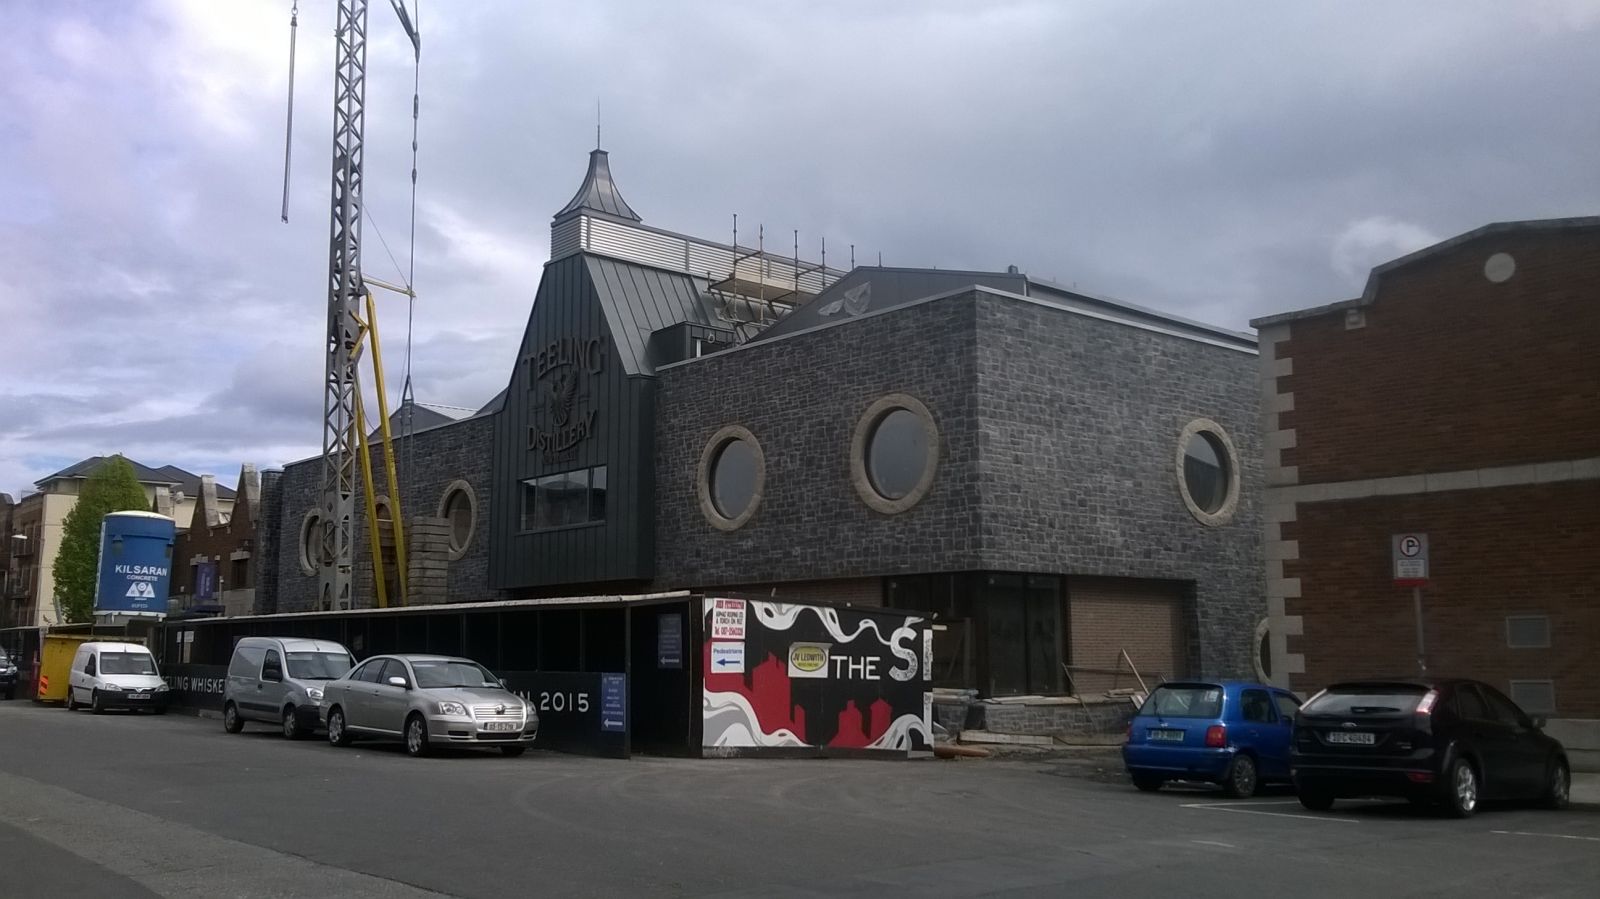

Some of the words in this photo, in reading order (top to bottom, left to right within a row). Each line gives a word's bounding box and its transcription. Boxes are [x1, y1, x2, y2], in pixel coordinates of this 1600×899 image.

[523, 336, 605, 391] TEELING
[526, 409, 599, 452] DISTILLERY
[115, 564, 168, 576] KILSARAN
[126, 574, 159, 582] CONCRETE
[830, 655, 881, 680] THE
[191, 677, 226, 693] WHISKE
[540, 691, 589, 713] 2015
